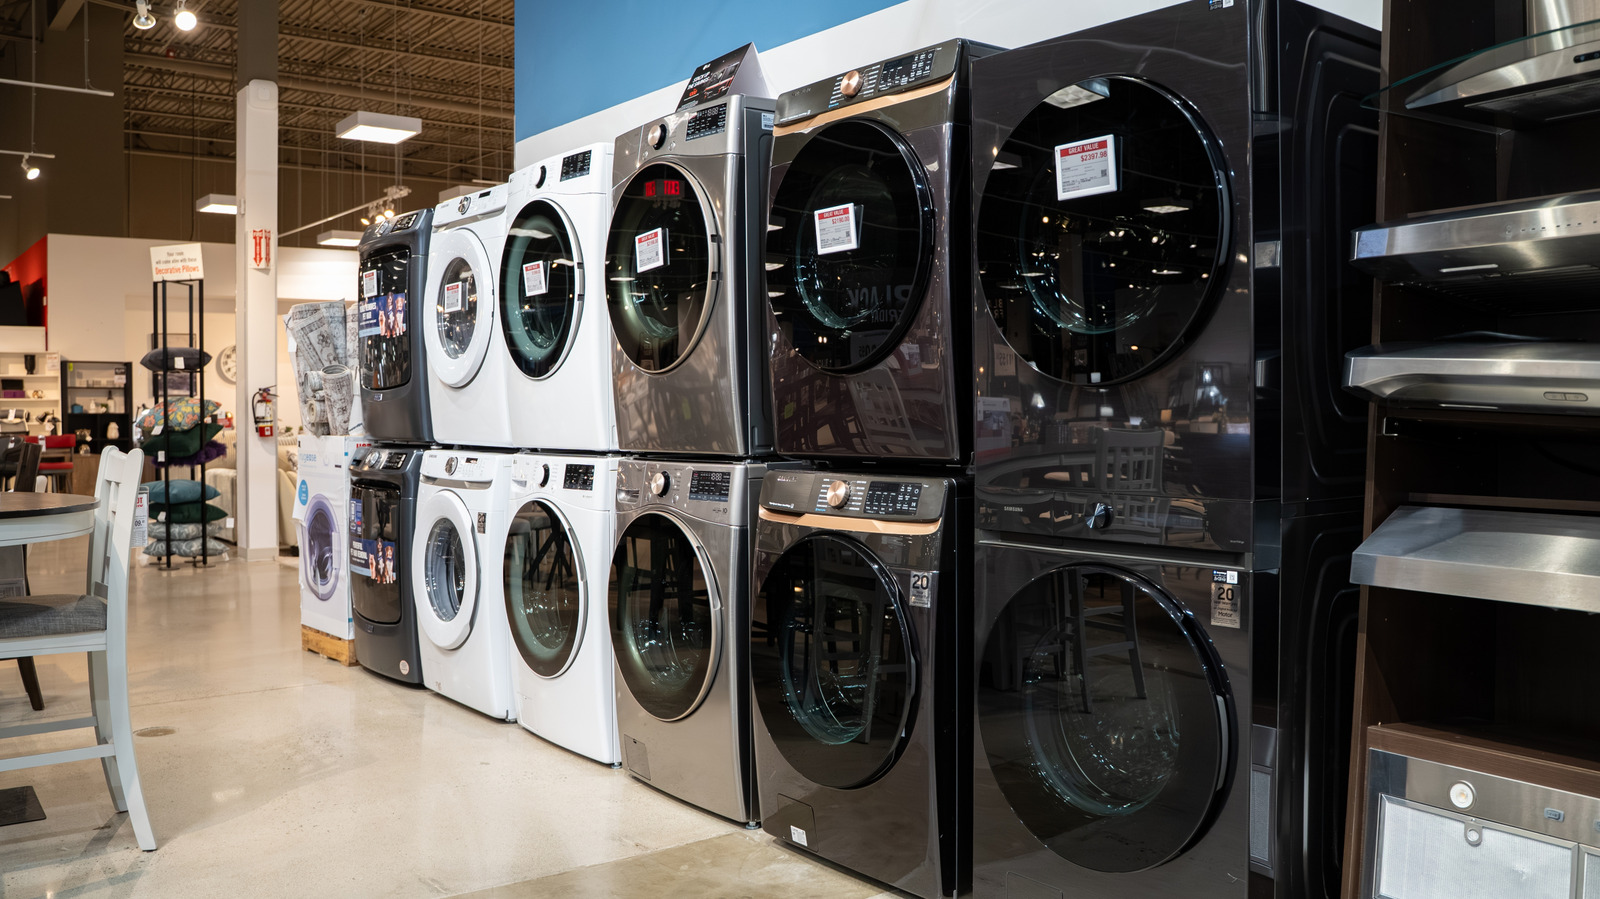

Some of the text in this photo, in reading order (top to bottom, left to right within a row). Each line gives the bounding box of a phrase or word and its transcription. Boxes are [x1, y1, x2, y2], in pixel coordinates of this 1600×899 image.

[1068, 142, 1099, 154] GREAT VALUE
[1080, 151, 1107, 162] $2397.98
[155, 264, 199, 275] Decorative Pillows
[912, 573, 930, 591] 20
[1217, 587, 1234, 601] 20
